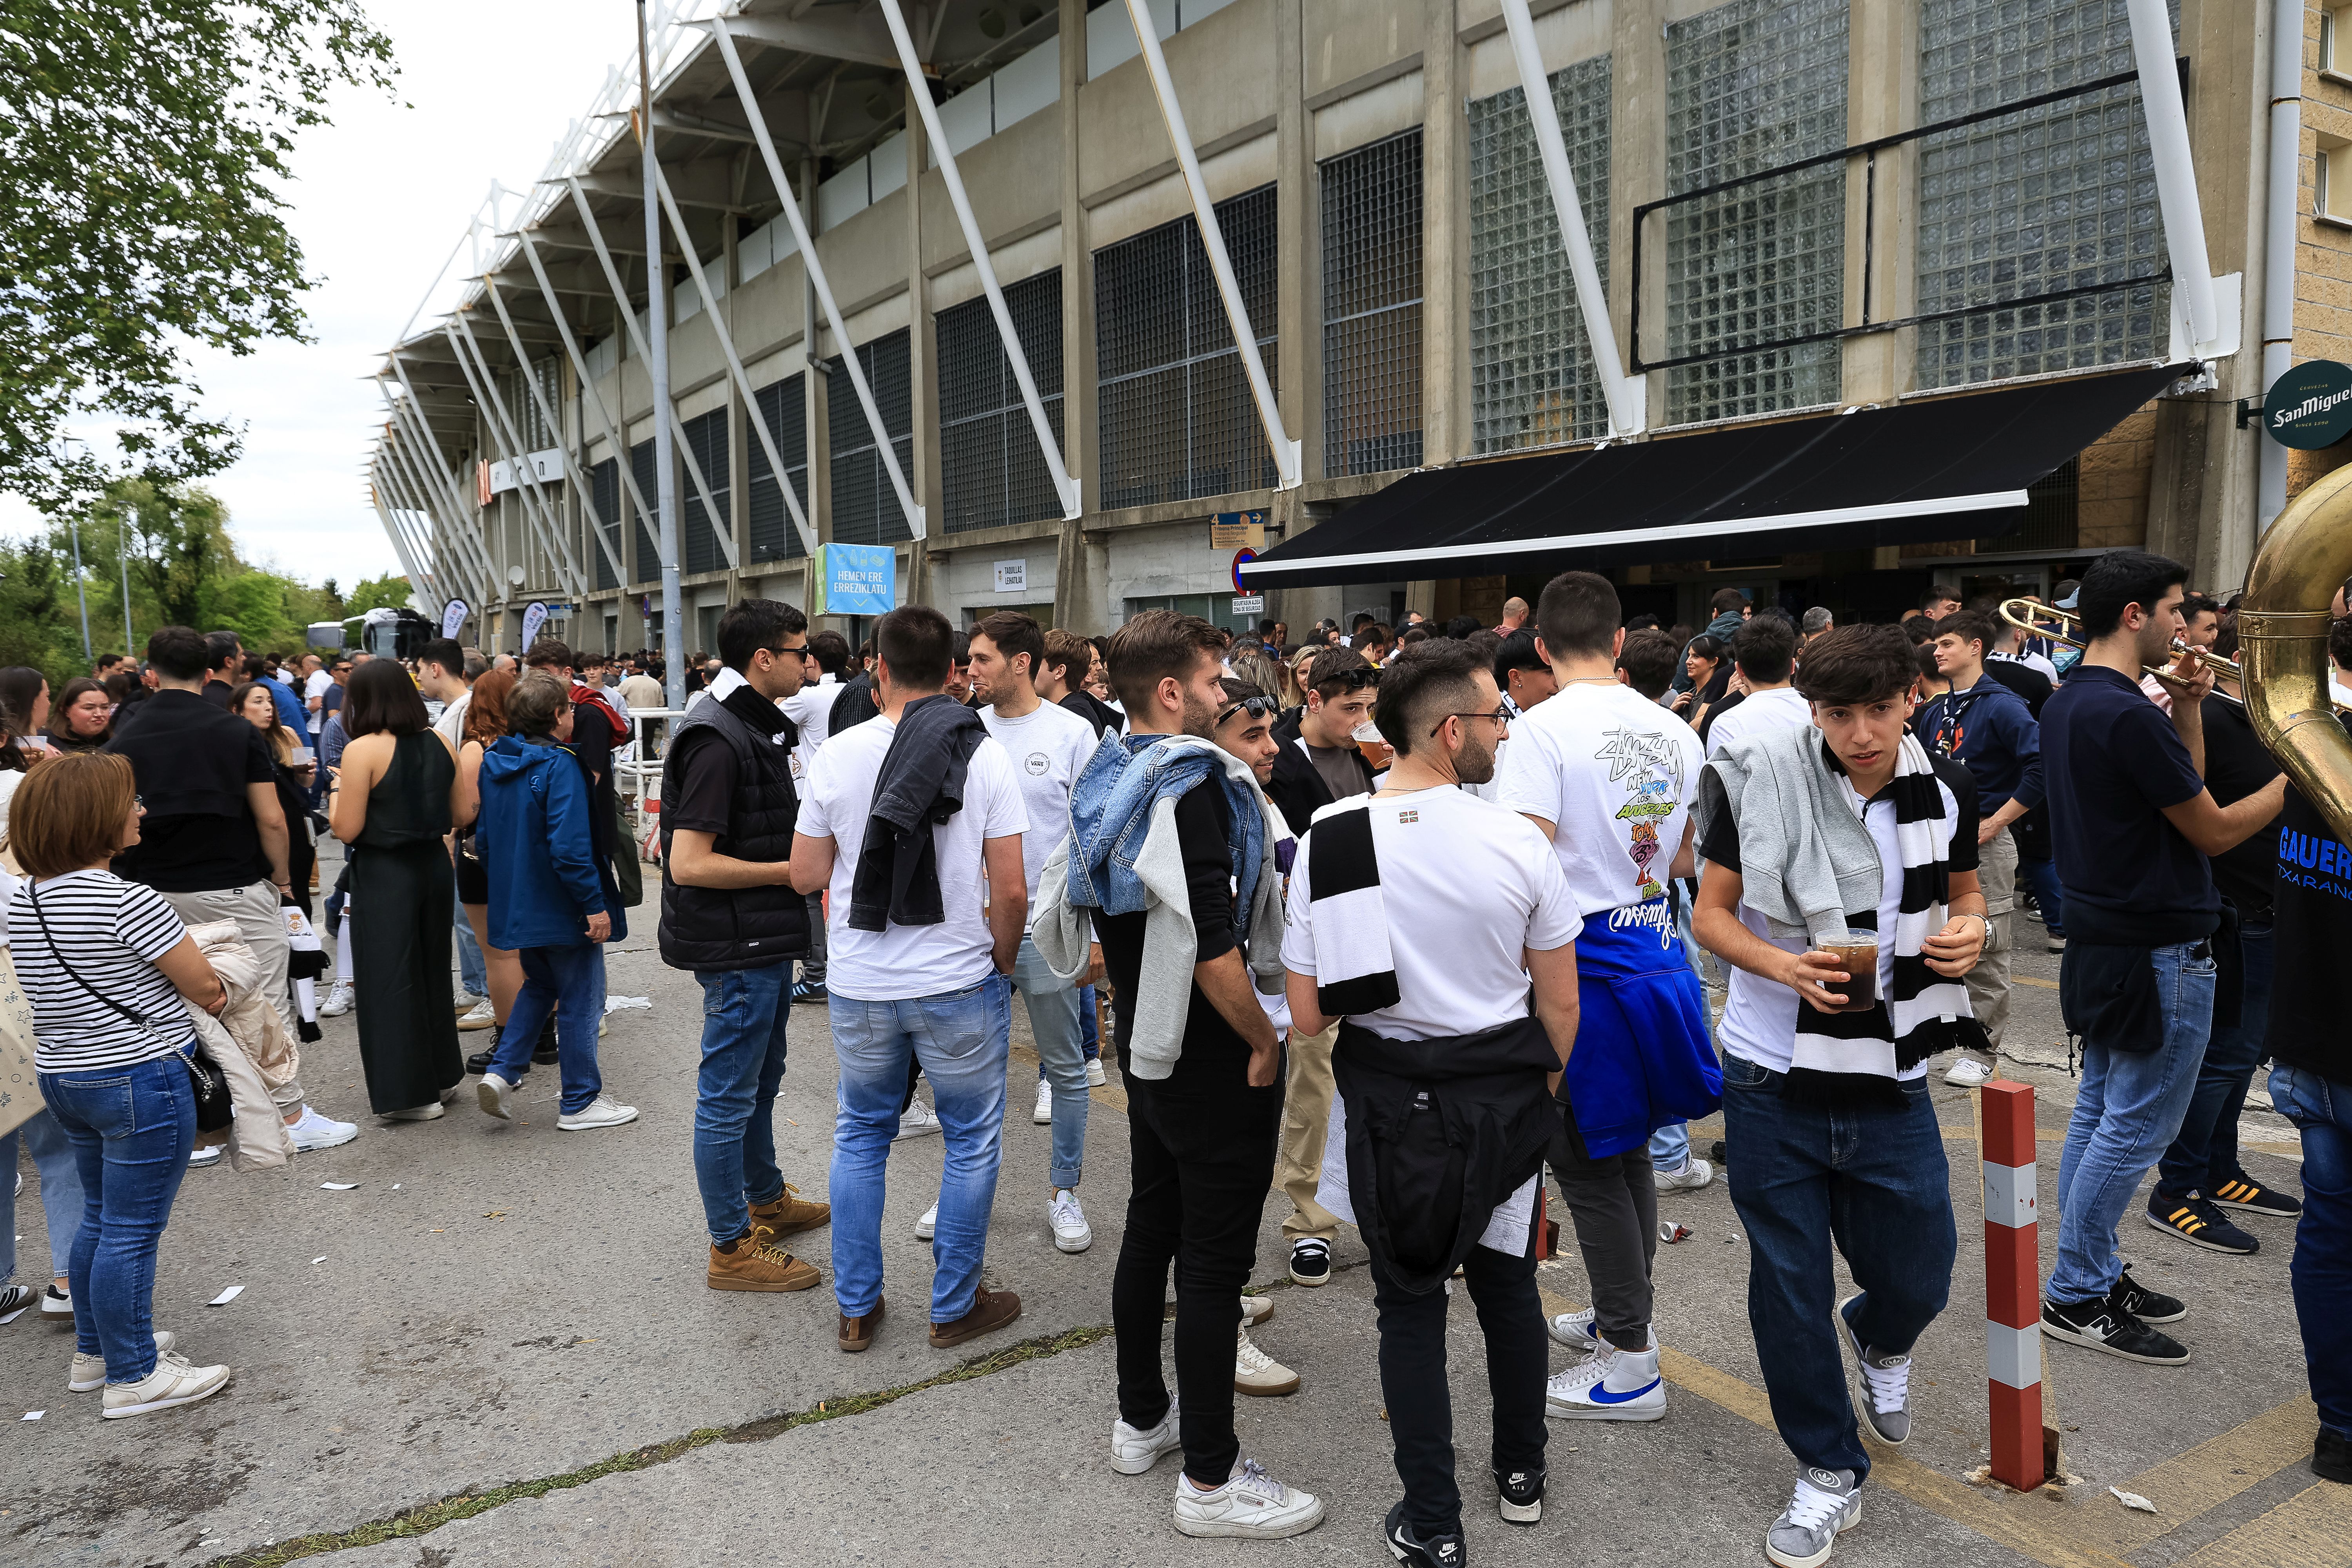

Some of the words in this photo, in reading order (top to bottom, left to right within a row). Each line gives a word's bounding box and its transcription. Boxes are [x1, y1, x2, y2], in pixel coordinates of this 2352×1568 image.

[1212, 514, 1219, 525] 4
[1004, 565, 1022, 574] TAQUILLAS
[837, 570, 866, 581] HEMEN
[868, 572, 883, 582] ERE
[834, 582, 887, 594] ERREZIKLATU
[1627, 770, 1653, 791] NEW
[1640, 780, 1669, 795] YORK
[1615, 802, 1674, 819] ANGELES
[1238, 1496, 1257, 1504] Reebok
[1442, 1543, 1455, 1551] NIKE
